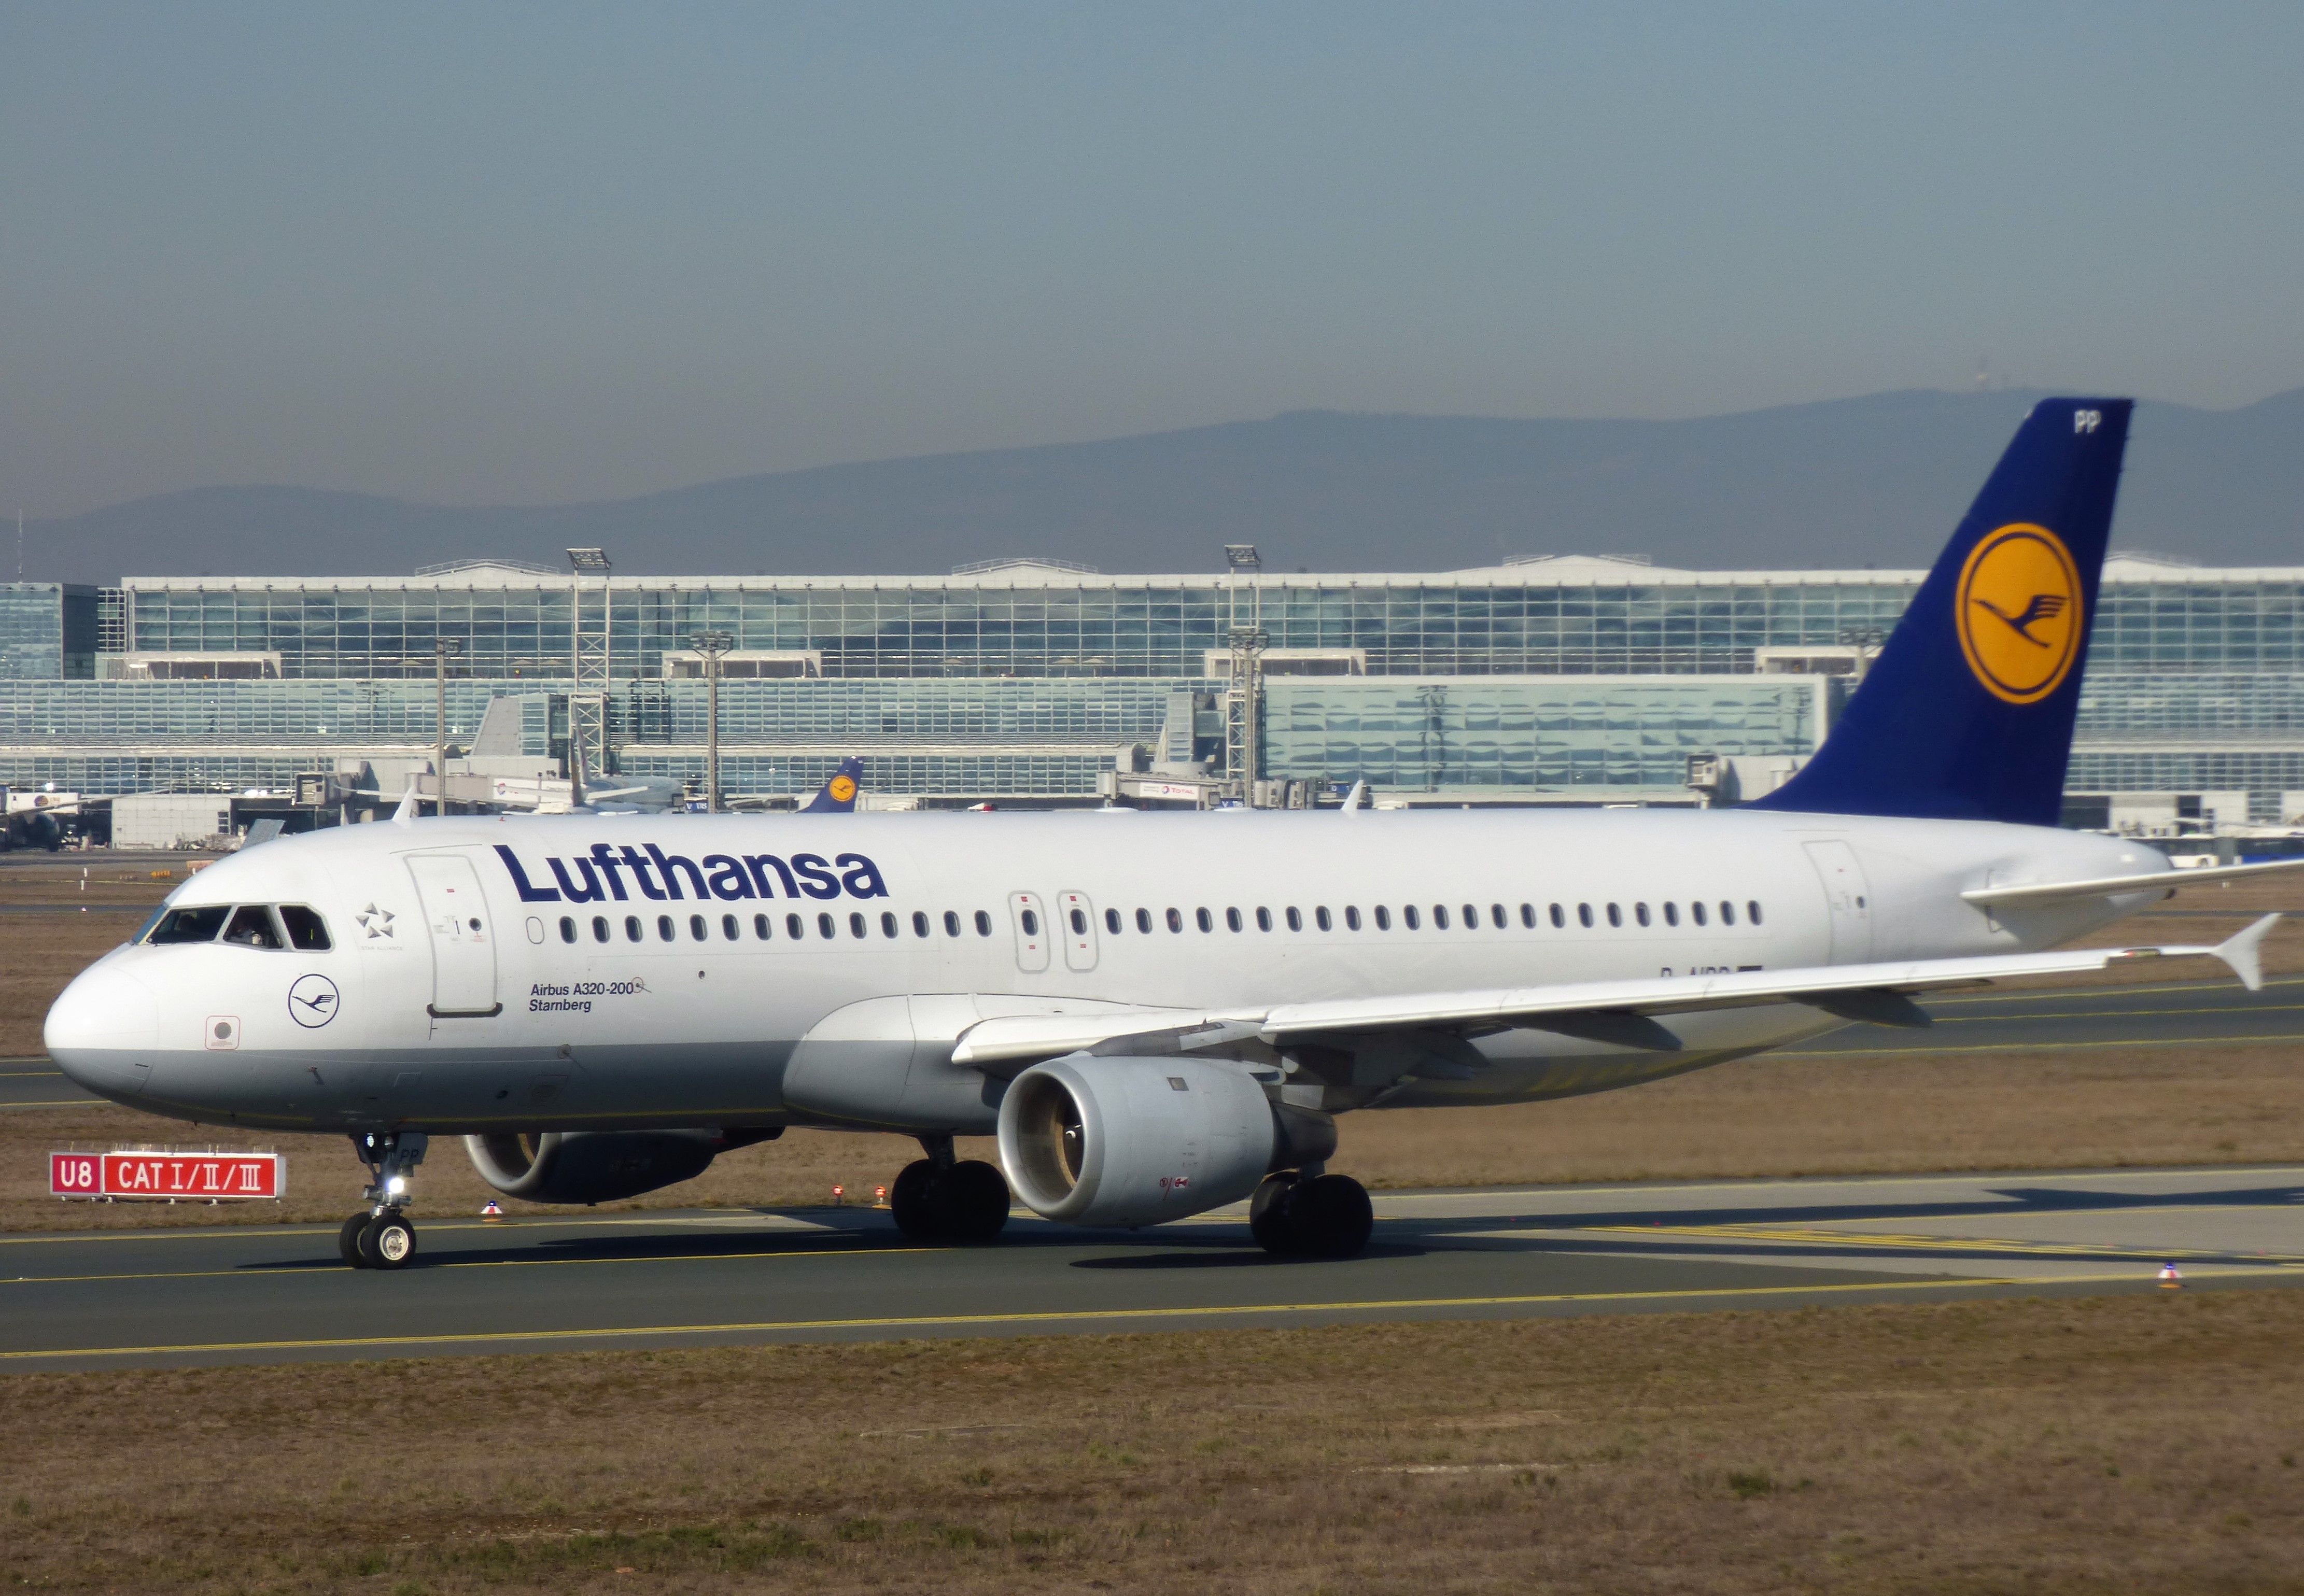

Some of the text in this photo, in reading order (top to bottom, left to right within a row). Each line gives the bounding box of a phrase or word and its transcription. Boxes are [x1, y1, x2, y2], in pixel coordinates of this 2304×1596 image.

[2075, 409, 2101, 433] PP
[493, 843, 889, 903] Lufthansa
[531, 982, 634, 995] Airbus A320-200
[529, 999, 591, 1012] Starnberg
[400, 1149, 419, 1161] PP
[61, 1161, 92, 1187] U8
[118, 1162, 163, 1189] CAT
